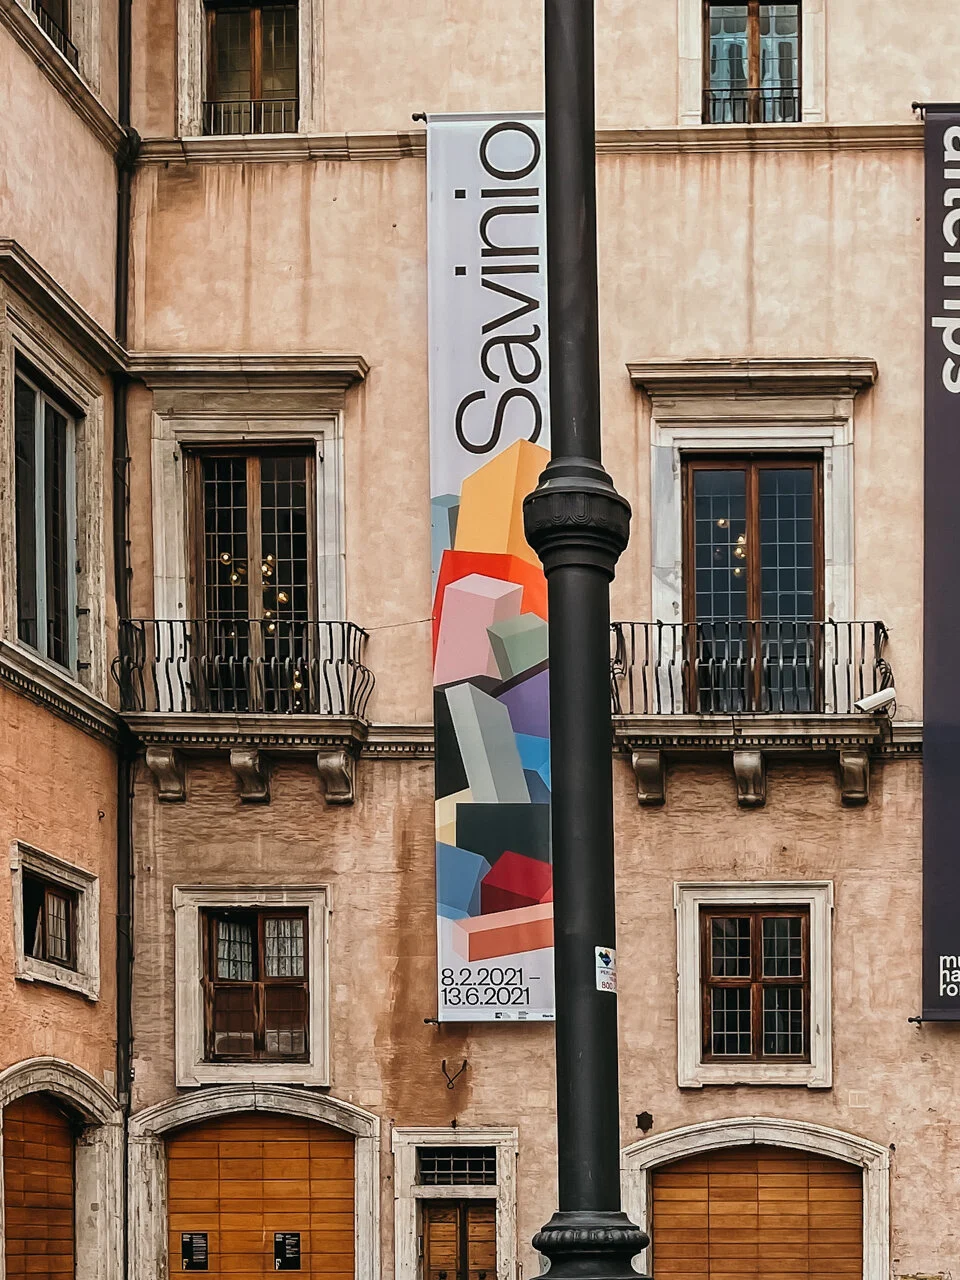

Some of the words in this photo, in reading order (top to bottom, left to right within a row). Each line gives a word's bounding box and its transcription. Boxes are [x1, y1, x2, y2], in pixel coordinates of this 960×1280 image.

[455, 121, 541, 454] Savinio
[441, 967, 523, 986] 8.2.2021
[441, 986, 530, 1006] 13.6.2021
